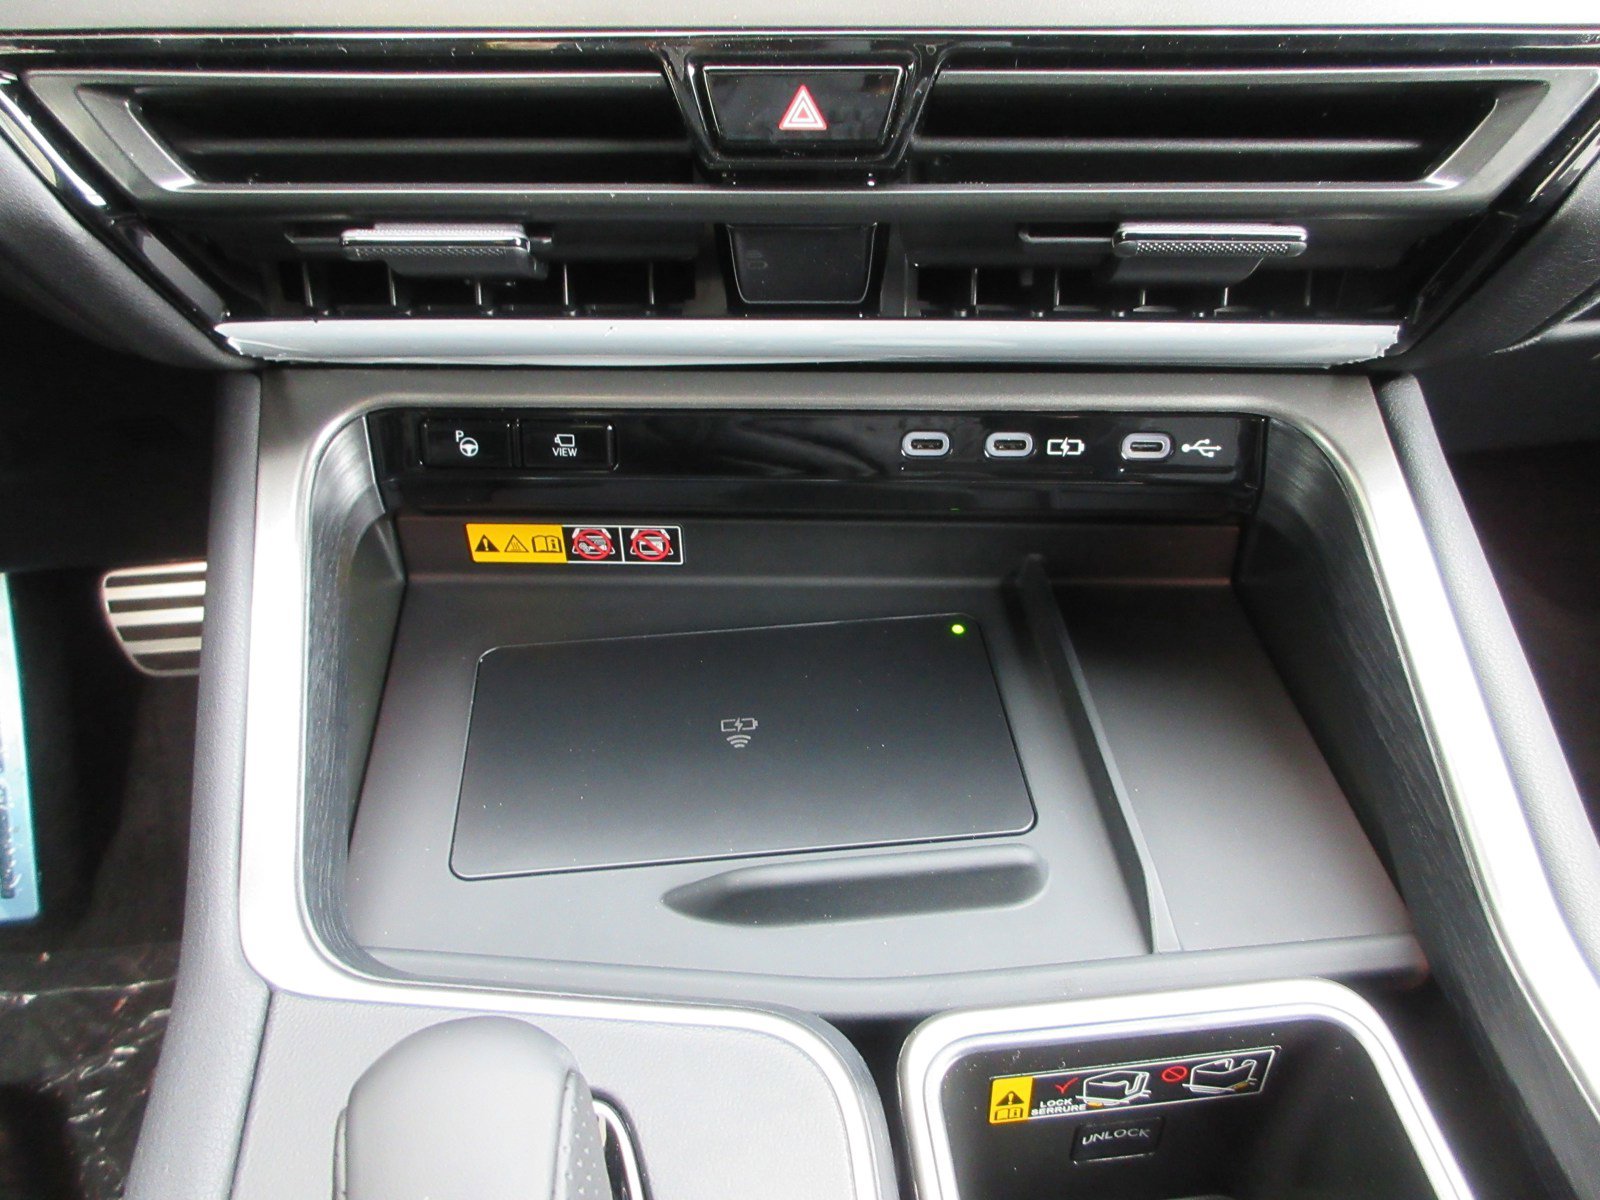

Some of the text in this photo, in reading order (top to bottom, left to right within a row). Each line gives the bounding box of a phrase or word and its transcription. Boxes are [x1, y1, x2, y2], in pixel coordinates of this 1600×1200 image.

[552, 447, 578, 457] VIEW
[1040, 1098, 1073, 1108] LOCK
[1031, 1104, 1086, 1116] SERRURE
[1082, 1128, 1151, 1145] UNLOCK
